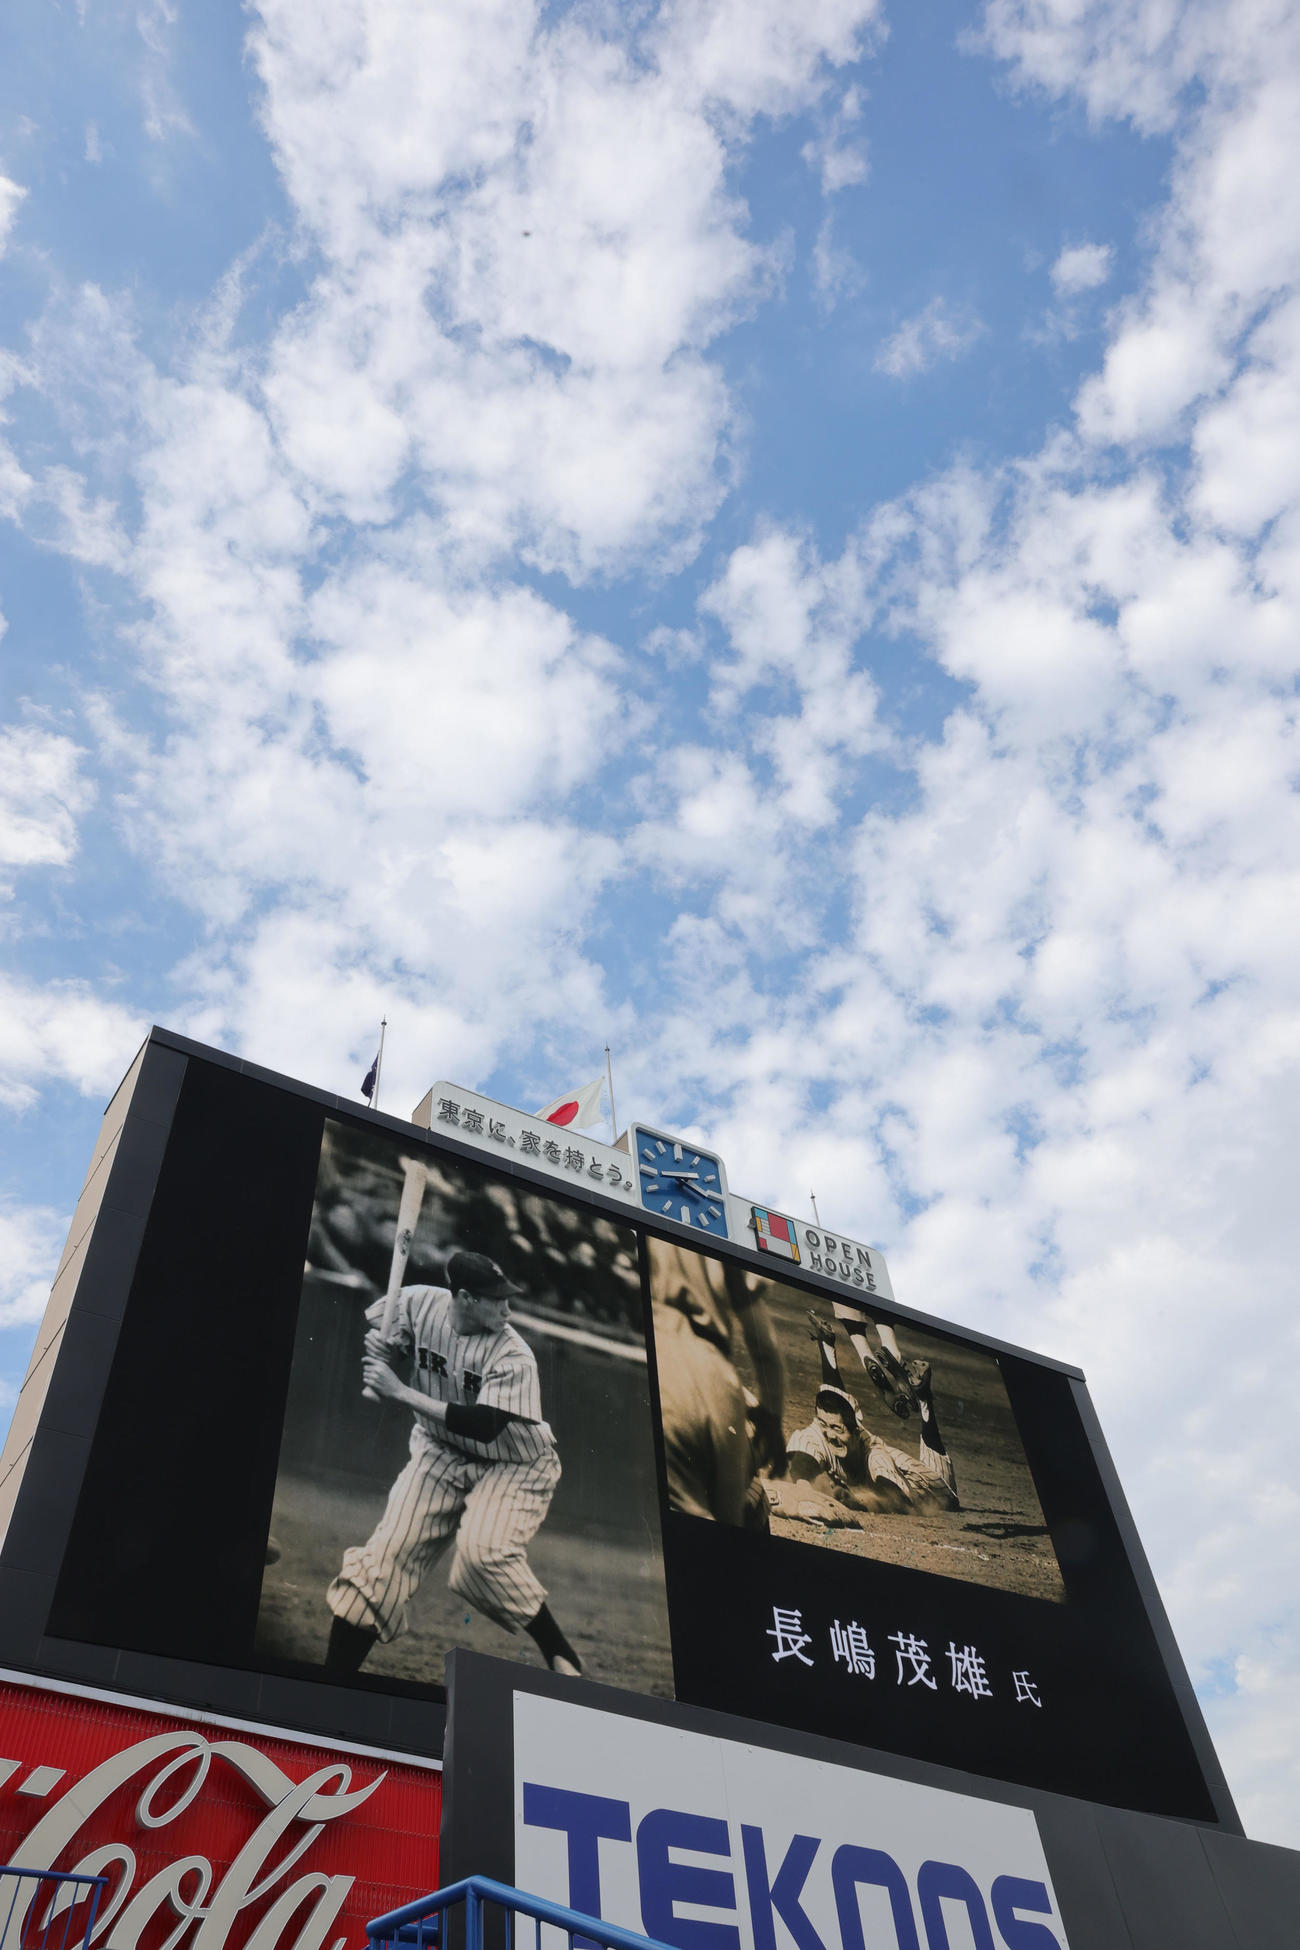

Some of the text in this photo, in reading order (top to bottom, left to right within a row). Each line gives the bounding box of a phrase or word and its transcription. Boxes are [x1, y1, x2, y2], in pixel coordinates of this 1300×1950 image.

[438, 1097, 634, 1190] 東京に、家を持とう。
[805, 1229, 872, 1269] OPEN
[810, 1251, 877, 1289] HOUSE
